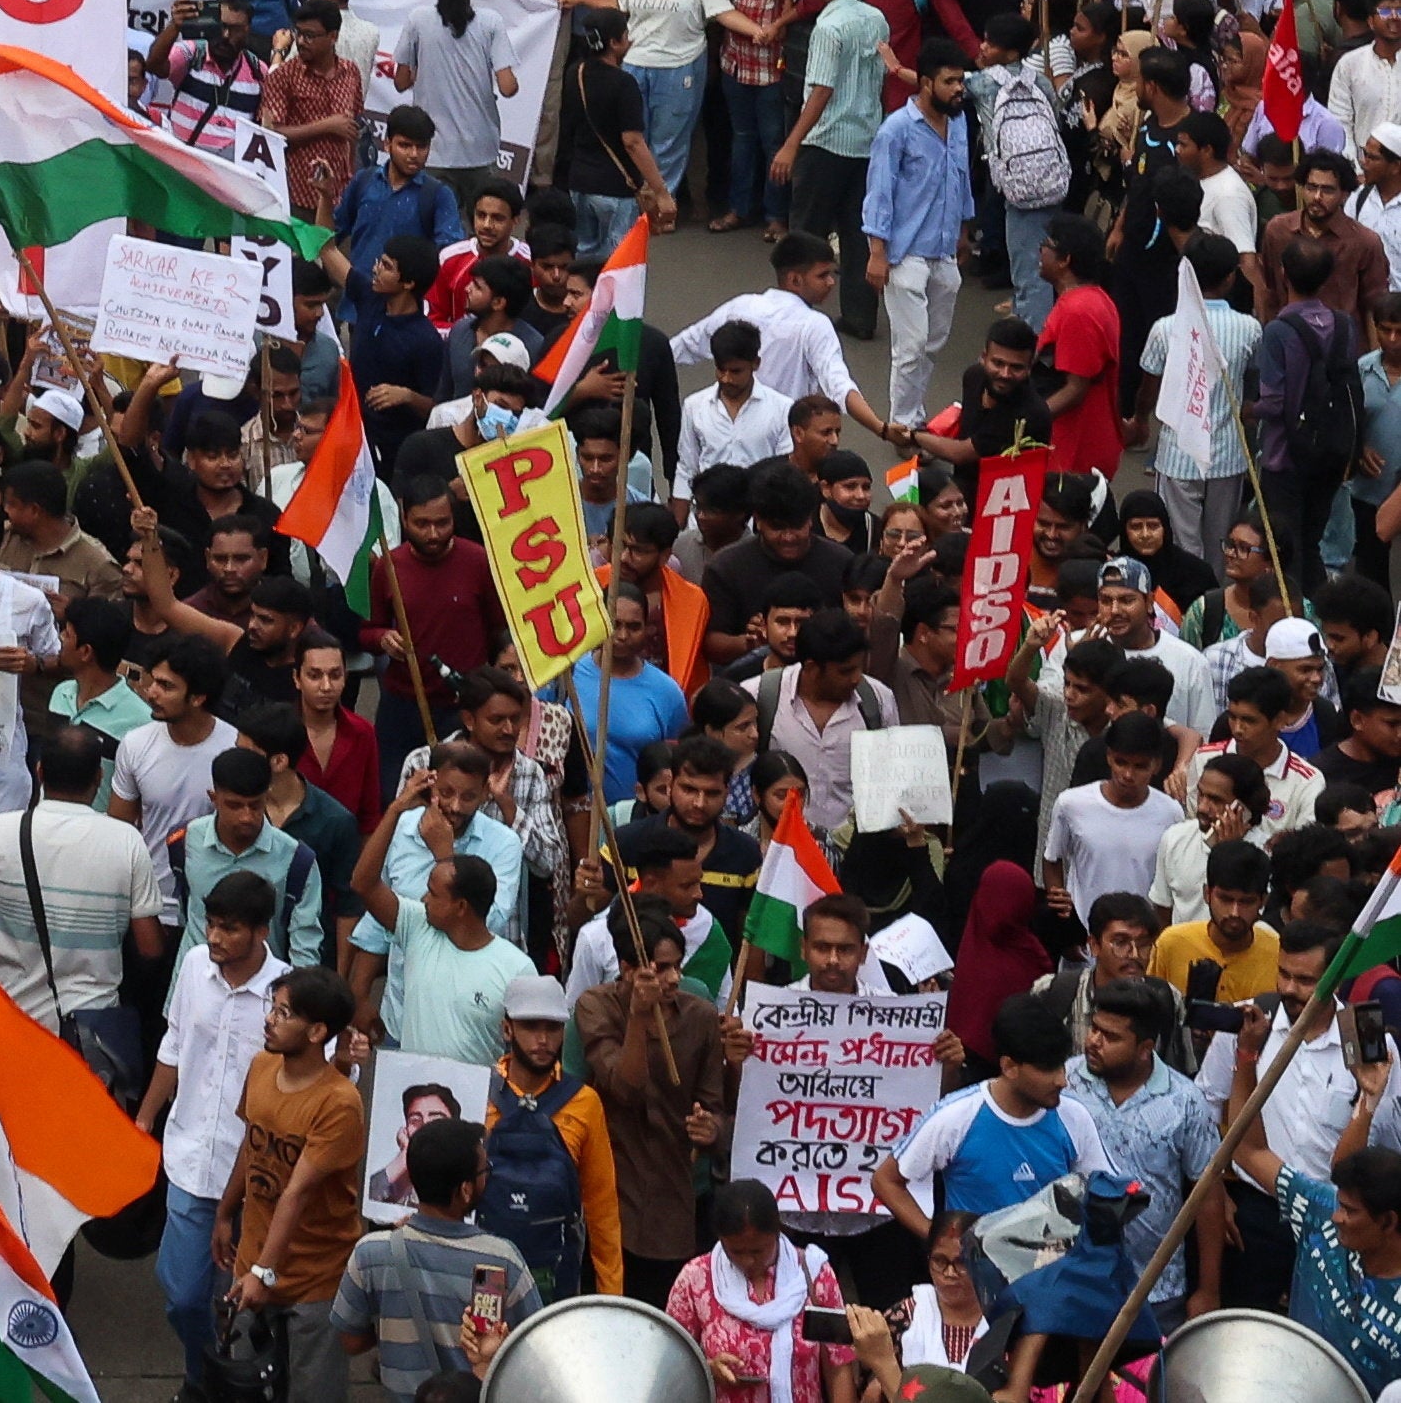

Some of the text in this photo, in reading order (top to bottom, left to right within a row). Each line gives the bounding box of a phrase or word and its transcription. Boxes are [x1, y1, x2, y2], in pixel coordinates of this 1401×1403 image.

[112, 248, 250, 303] SARKAR KE 2
[129, 276, 232, 314] ACHIEVEMENTS
[484, 448, 588, 657] PSU
[965, 475, 1032, 670] AIDSO
[751, 999, 946, 1033] কেন্দ্রীয় শিক্ষামন্ত্রী
[751, 1033, 938, 1070] ধর্মেন্দ্র প্রধানকে
[778, 1072, 883, 1099] অবিলম্বে
[768, 1100, 922, 1144] পদত্যাগ
[755, 1142, 847, 1168] করতে
